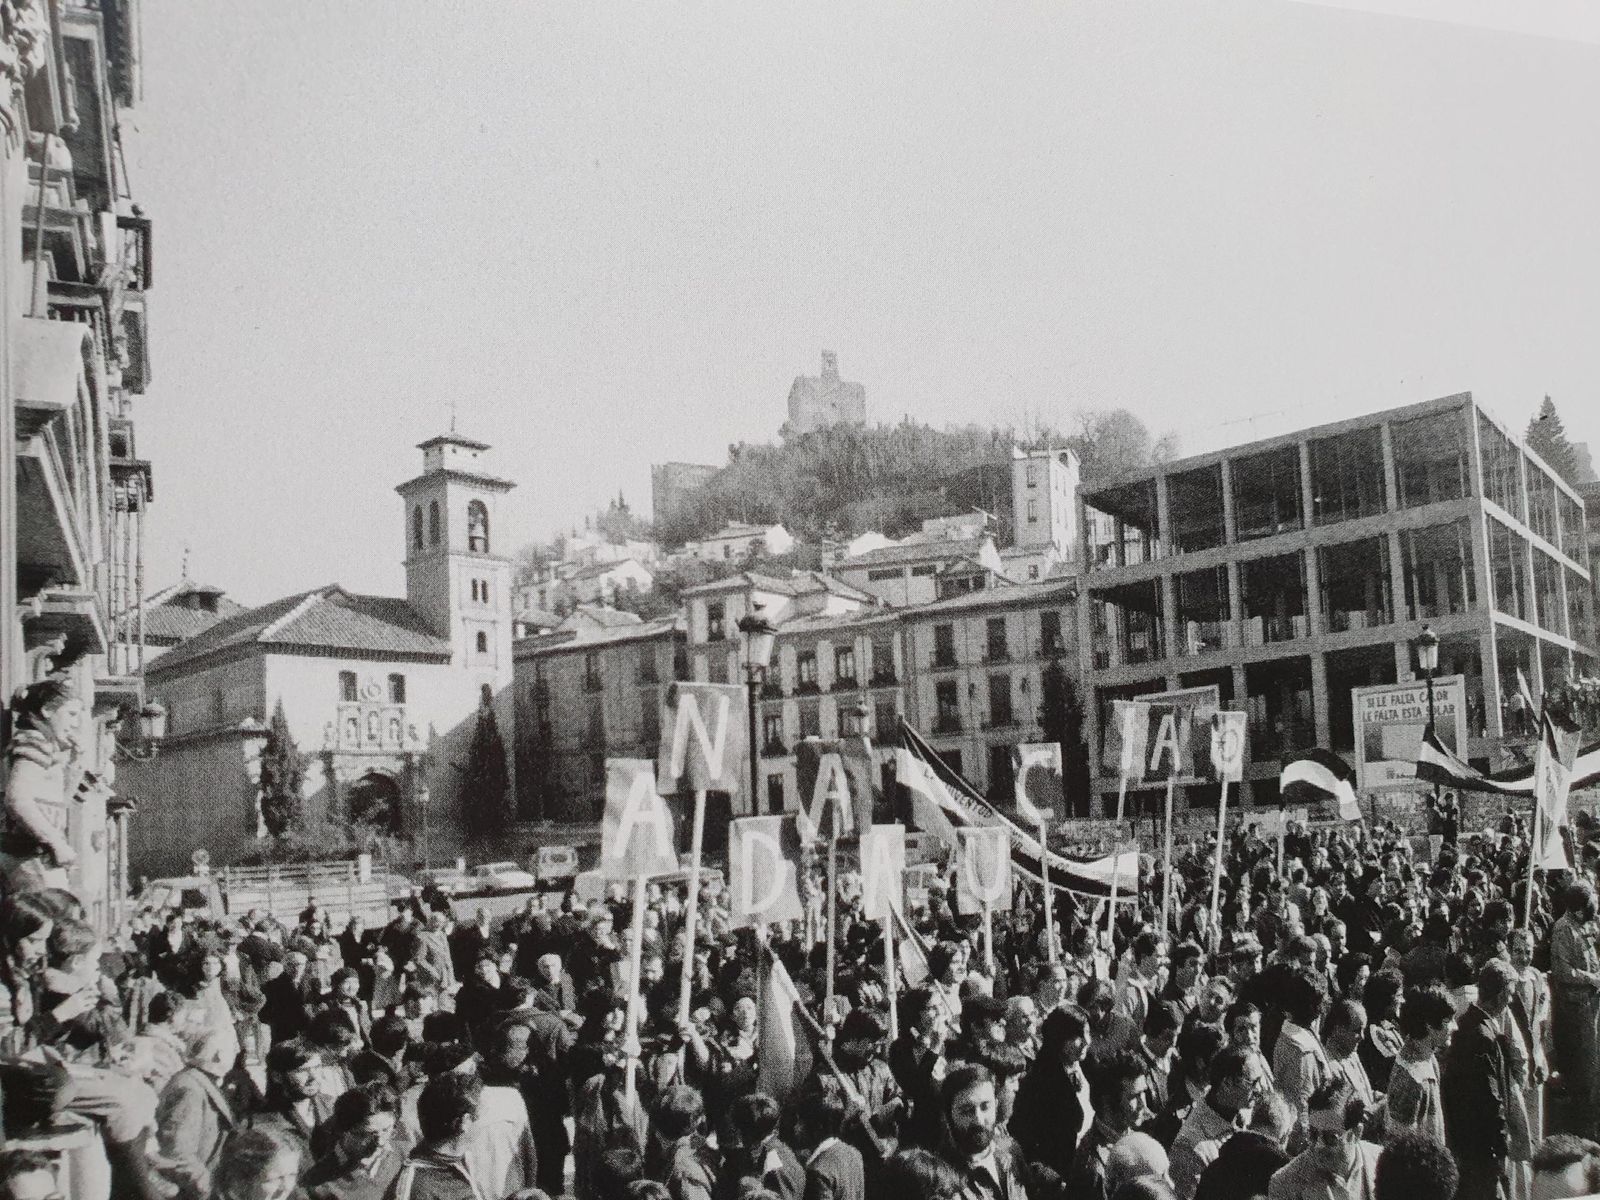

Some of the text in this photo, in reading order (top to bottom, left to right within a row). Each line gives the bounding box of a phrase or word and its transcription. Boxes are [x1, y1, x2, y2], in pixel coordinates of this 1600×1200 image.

[1374, 708, 1399, 722] FALTA
[1402, 706, 1423, 719] ESTA
[1390, 693, 1416, 706] FALTA
[1419, 690, 1448, 703] COR
[671, 693, 730, 780] N
[1150, 715, 1180, 771] A
[614, 771, 672, 858] A
[809, 753, 854, 833] A
[742, 831, 787, 915] D
[966, 835, 1007, 901] U
